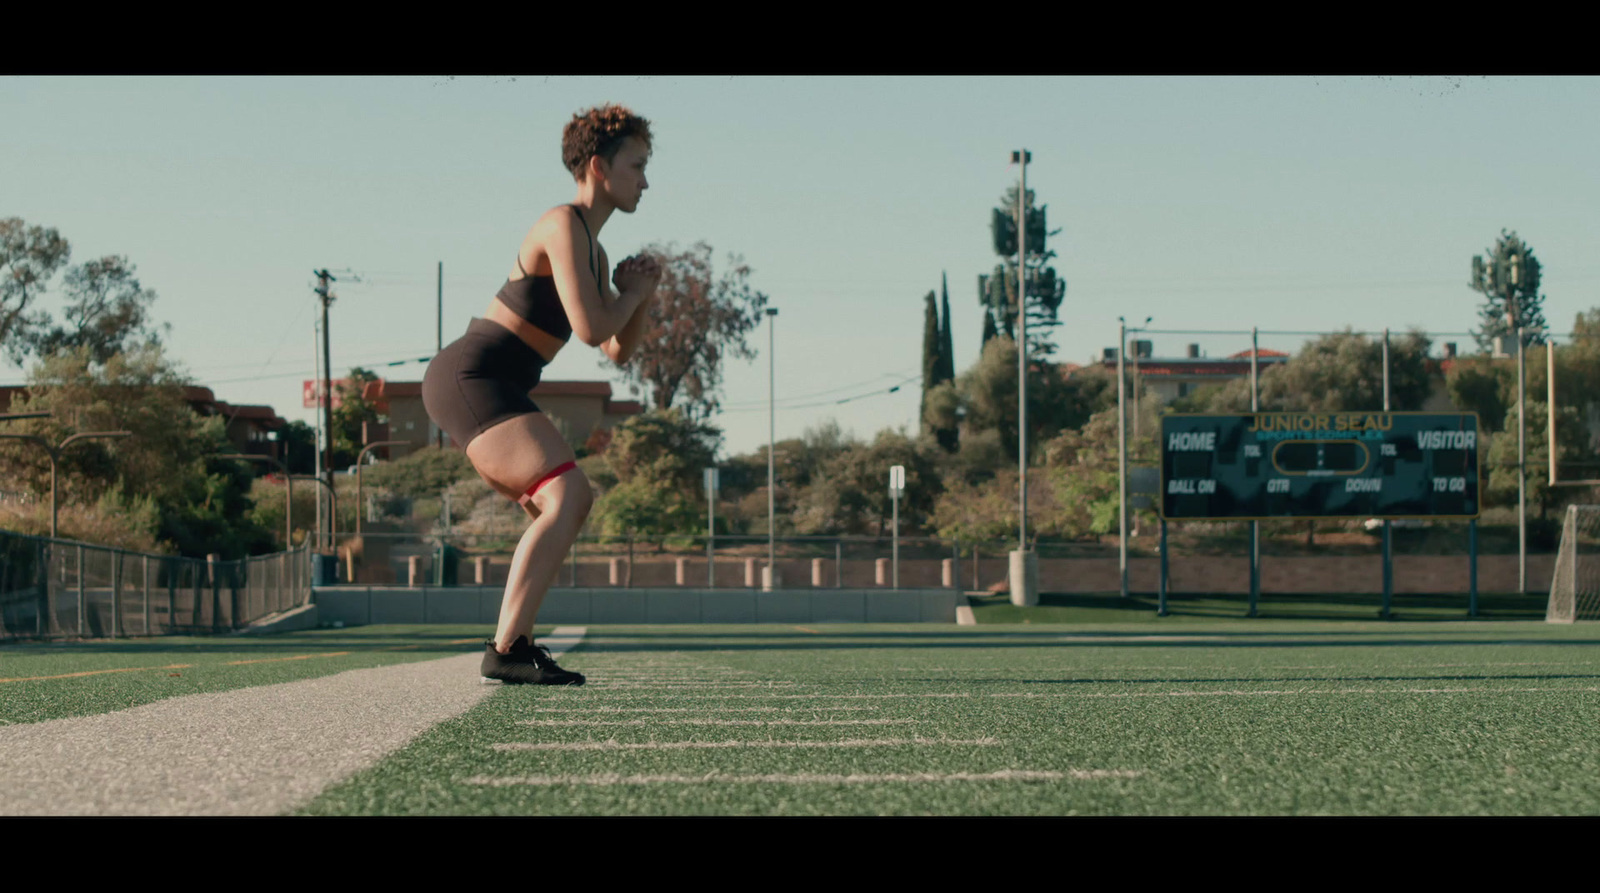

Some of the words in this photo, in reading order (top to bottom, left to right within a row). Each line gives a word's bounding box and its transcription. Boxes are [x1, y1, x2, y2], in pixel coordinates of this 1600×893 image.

[1248, 415, 1330, 431] JUNIOR
[1336, 415, 1392, 430] SEAU
[1169, 432, 1215, 450] HOME
[1418, 431, 1475, 448] VISITOR
[1168, 480, 1195, 493] BALL
[1198, 480, 1215, 493] ON
[1267, 479, 1290, 493] QTR
[1346, 479, 1382, 492] DOWN
[1433, 478, 1446, 491] TO
[1449, 478, 1465, 491] GO
